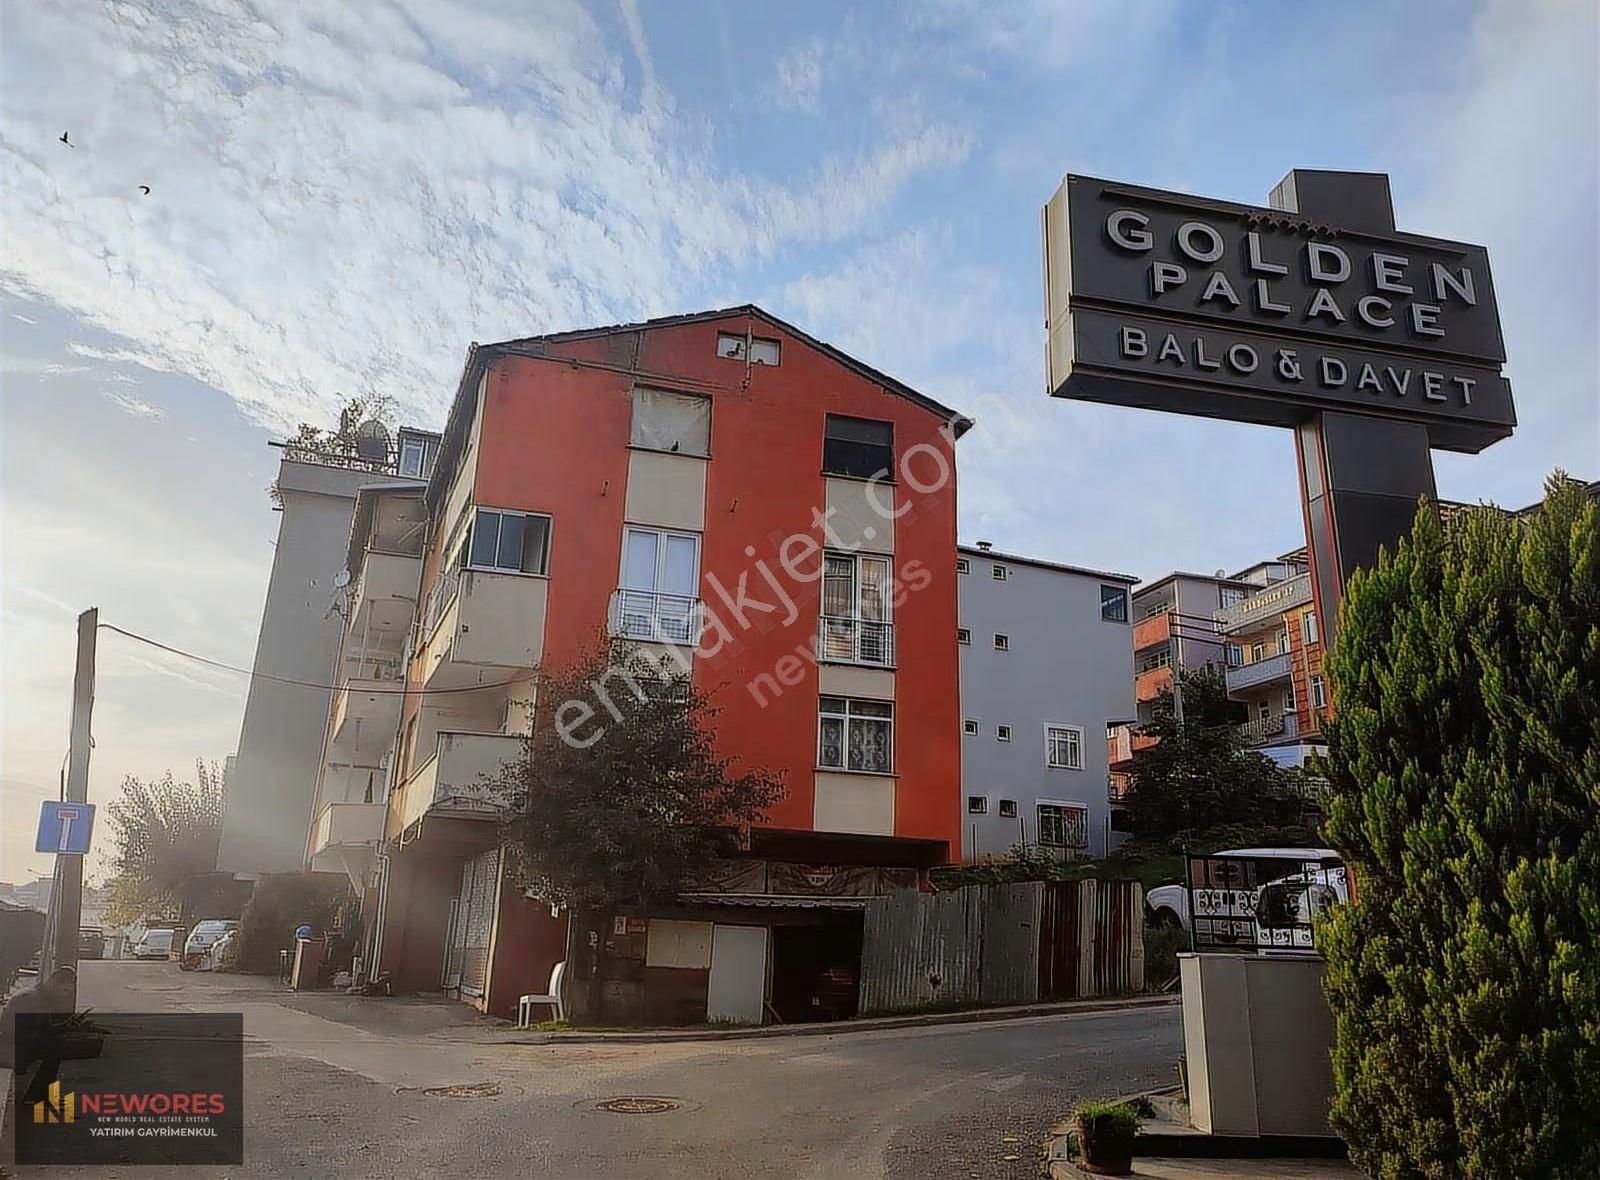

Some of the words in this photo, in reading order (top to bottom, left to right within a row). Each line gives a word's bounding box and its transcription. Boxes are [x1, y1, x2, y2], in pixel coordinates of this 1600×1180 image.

[1107, 209, 1476, 305] GOLDEN
[1152, 260, 1446, 337] PALACE
[1120, 325, 1259, 373] BALO
[1278, 349, 1304, 381] &
[1321, 356, 1477, 405] DAVET
